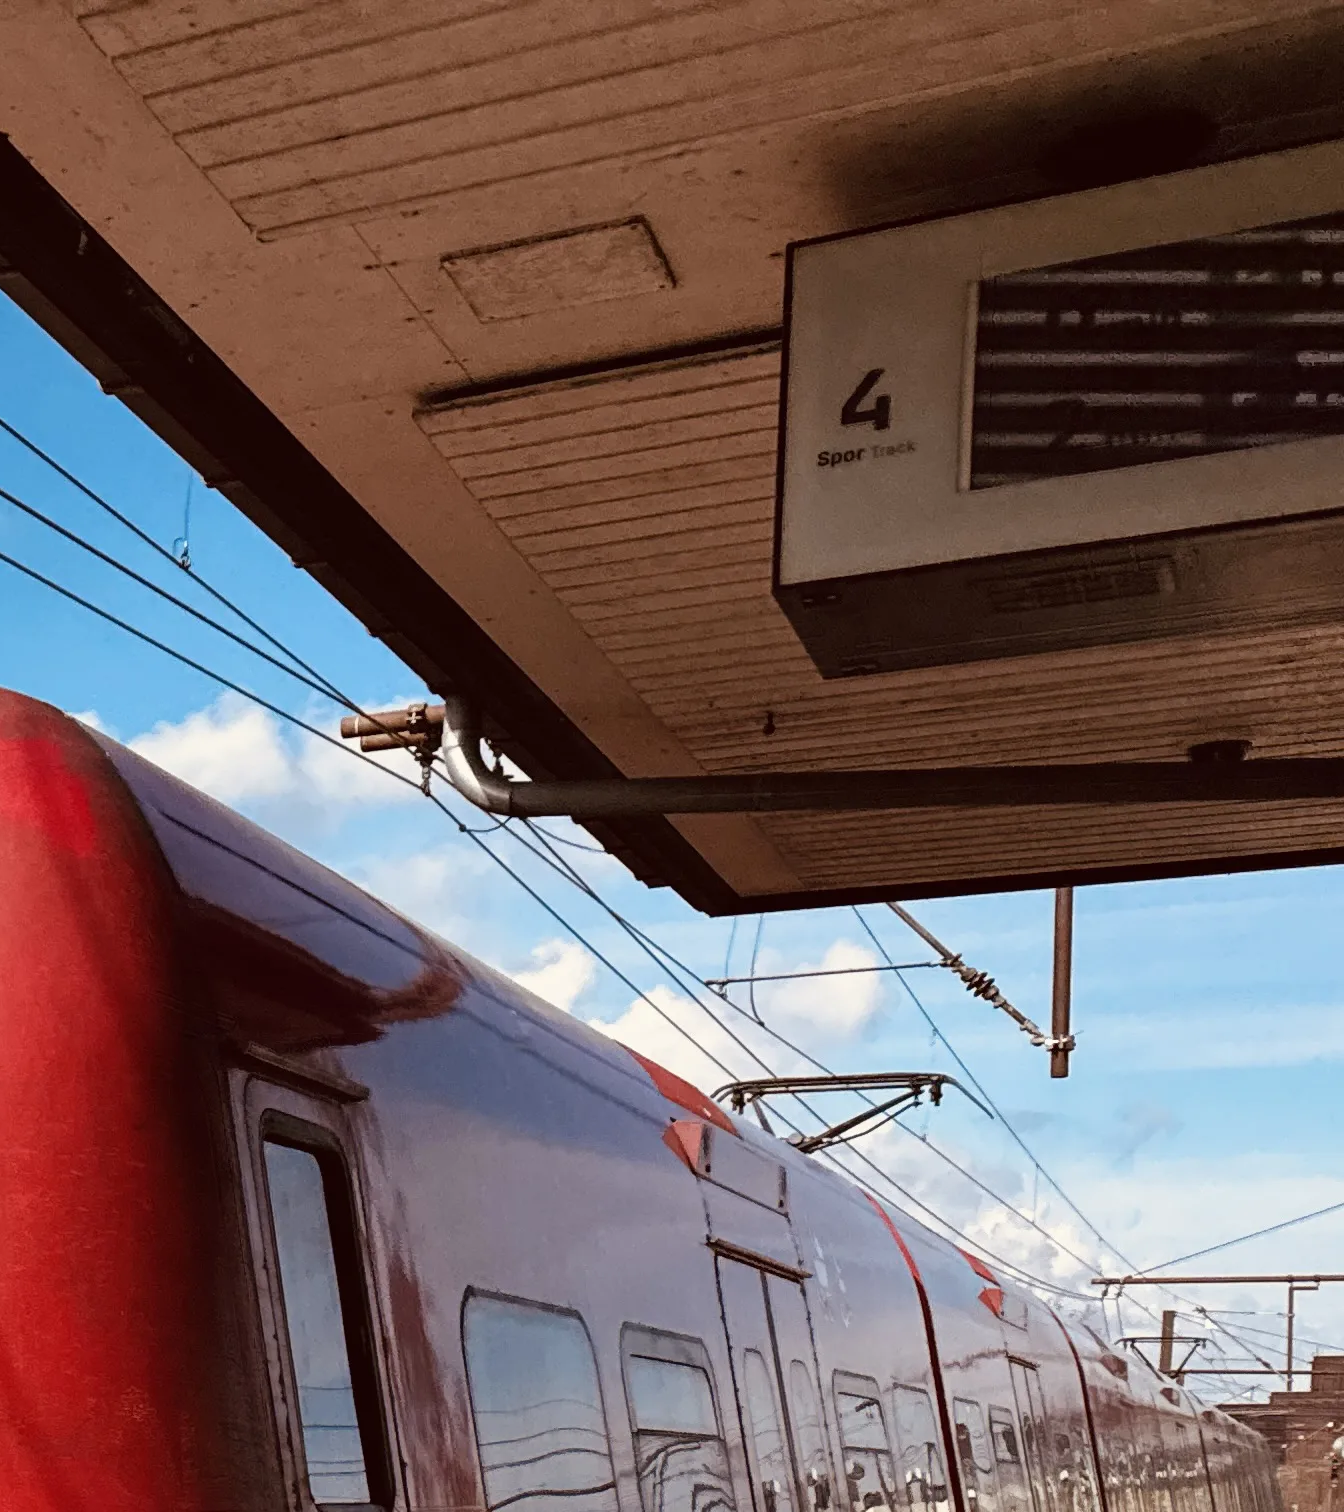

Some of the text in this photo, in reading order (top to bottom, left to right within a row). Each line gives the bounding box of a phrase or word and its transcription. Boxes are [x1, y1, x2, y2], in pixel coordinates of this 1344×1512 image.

[841, 368, 891, 430] 4
[817, 441, 917, 467] Spor Track
